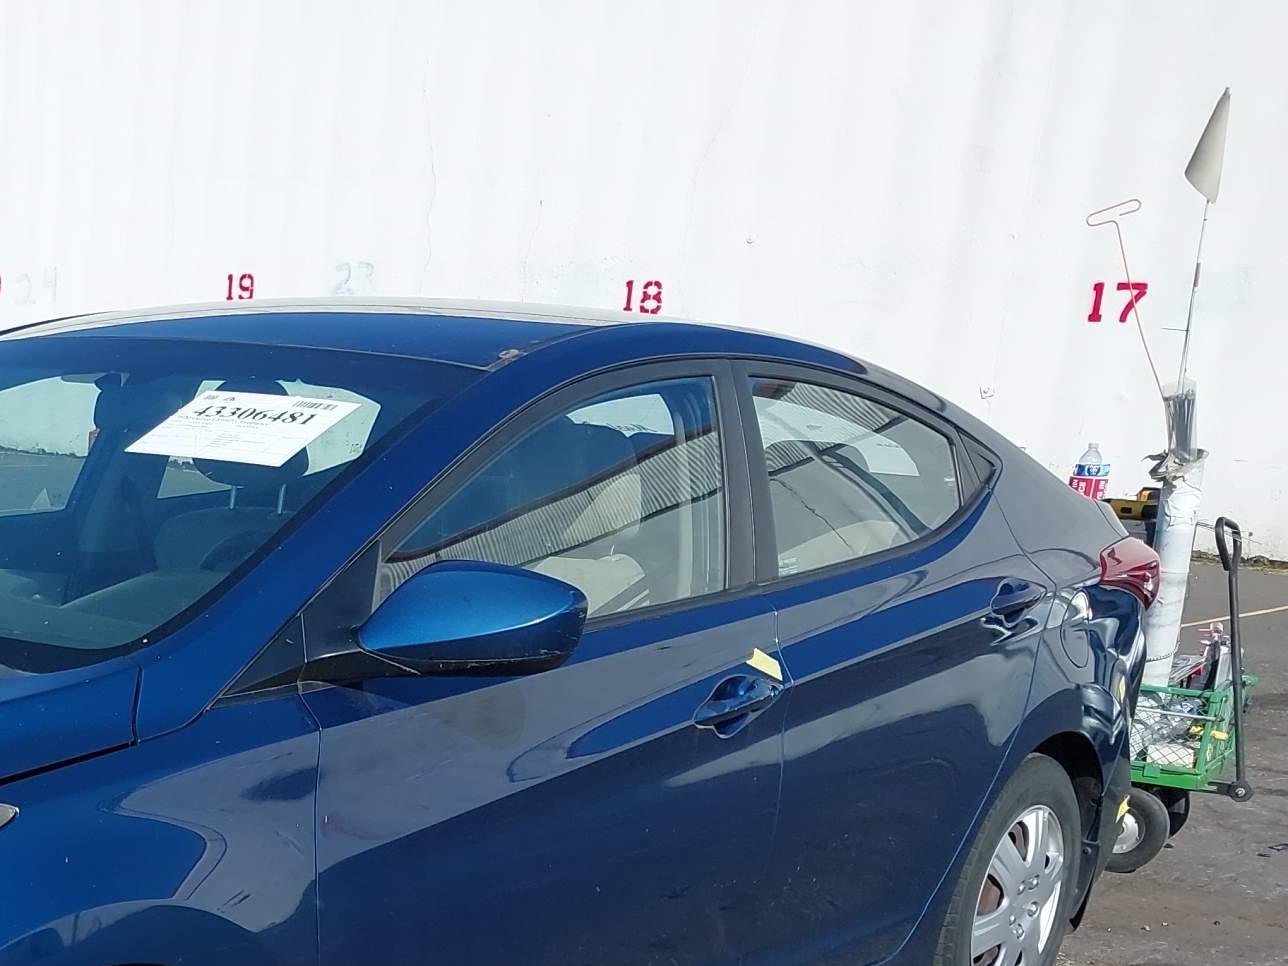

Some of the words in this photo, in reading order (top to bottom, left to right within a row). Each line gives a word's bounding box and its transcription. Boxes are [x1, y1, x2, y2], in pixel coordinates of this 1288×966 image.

[226, 273, 255, 301] 19
[623, 279, 663, 315] 18
[1087, 281, 1148, 323] 17
[193, 404, 318, 425] 43306481
